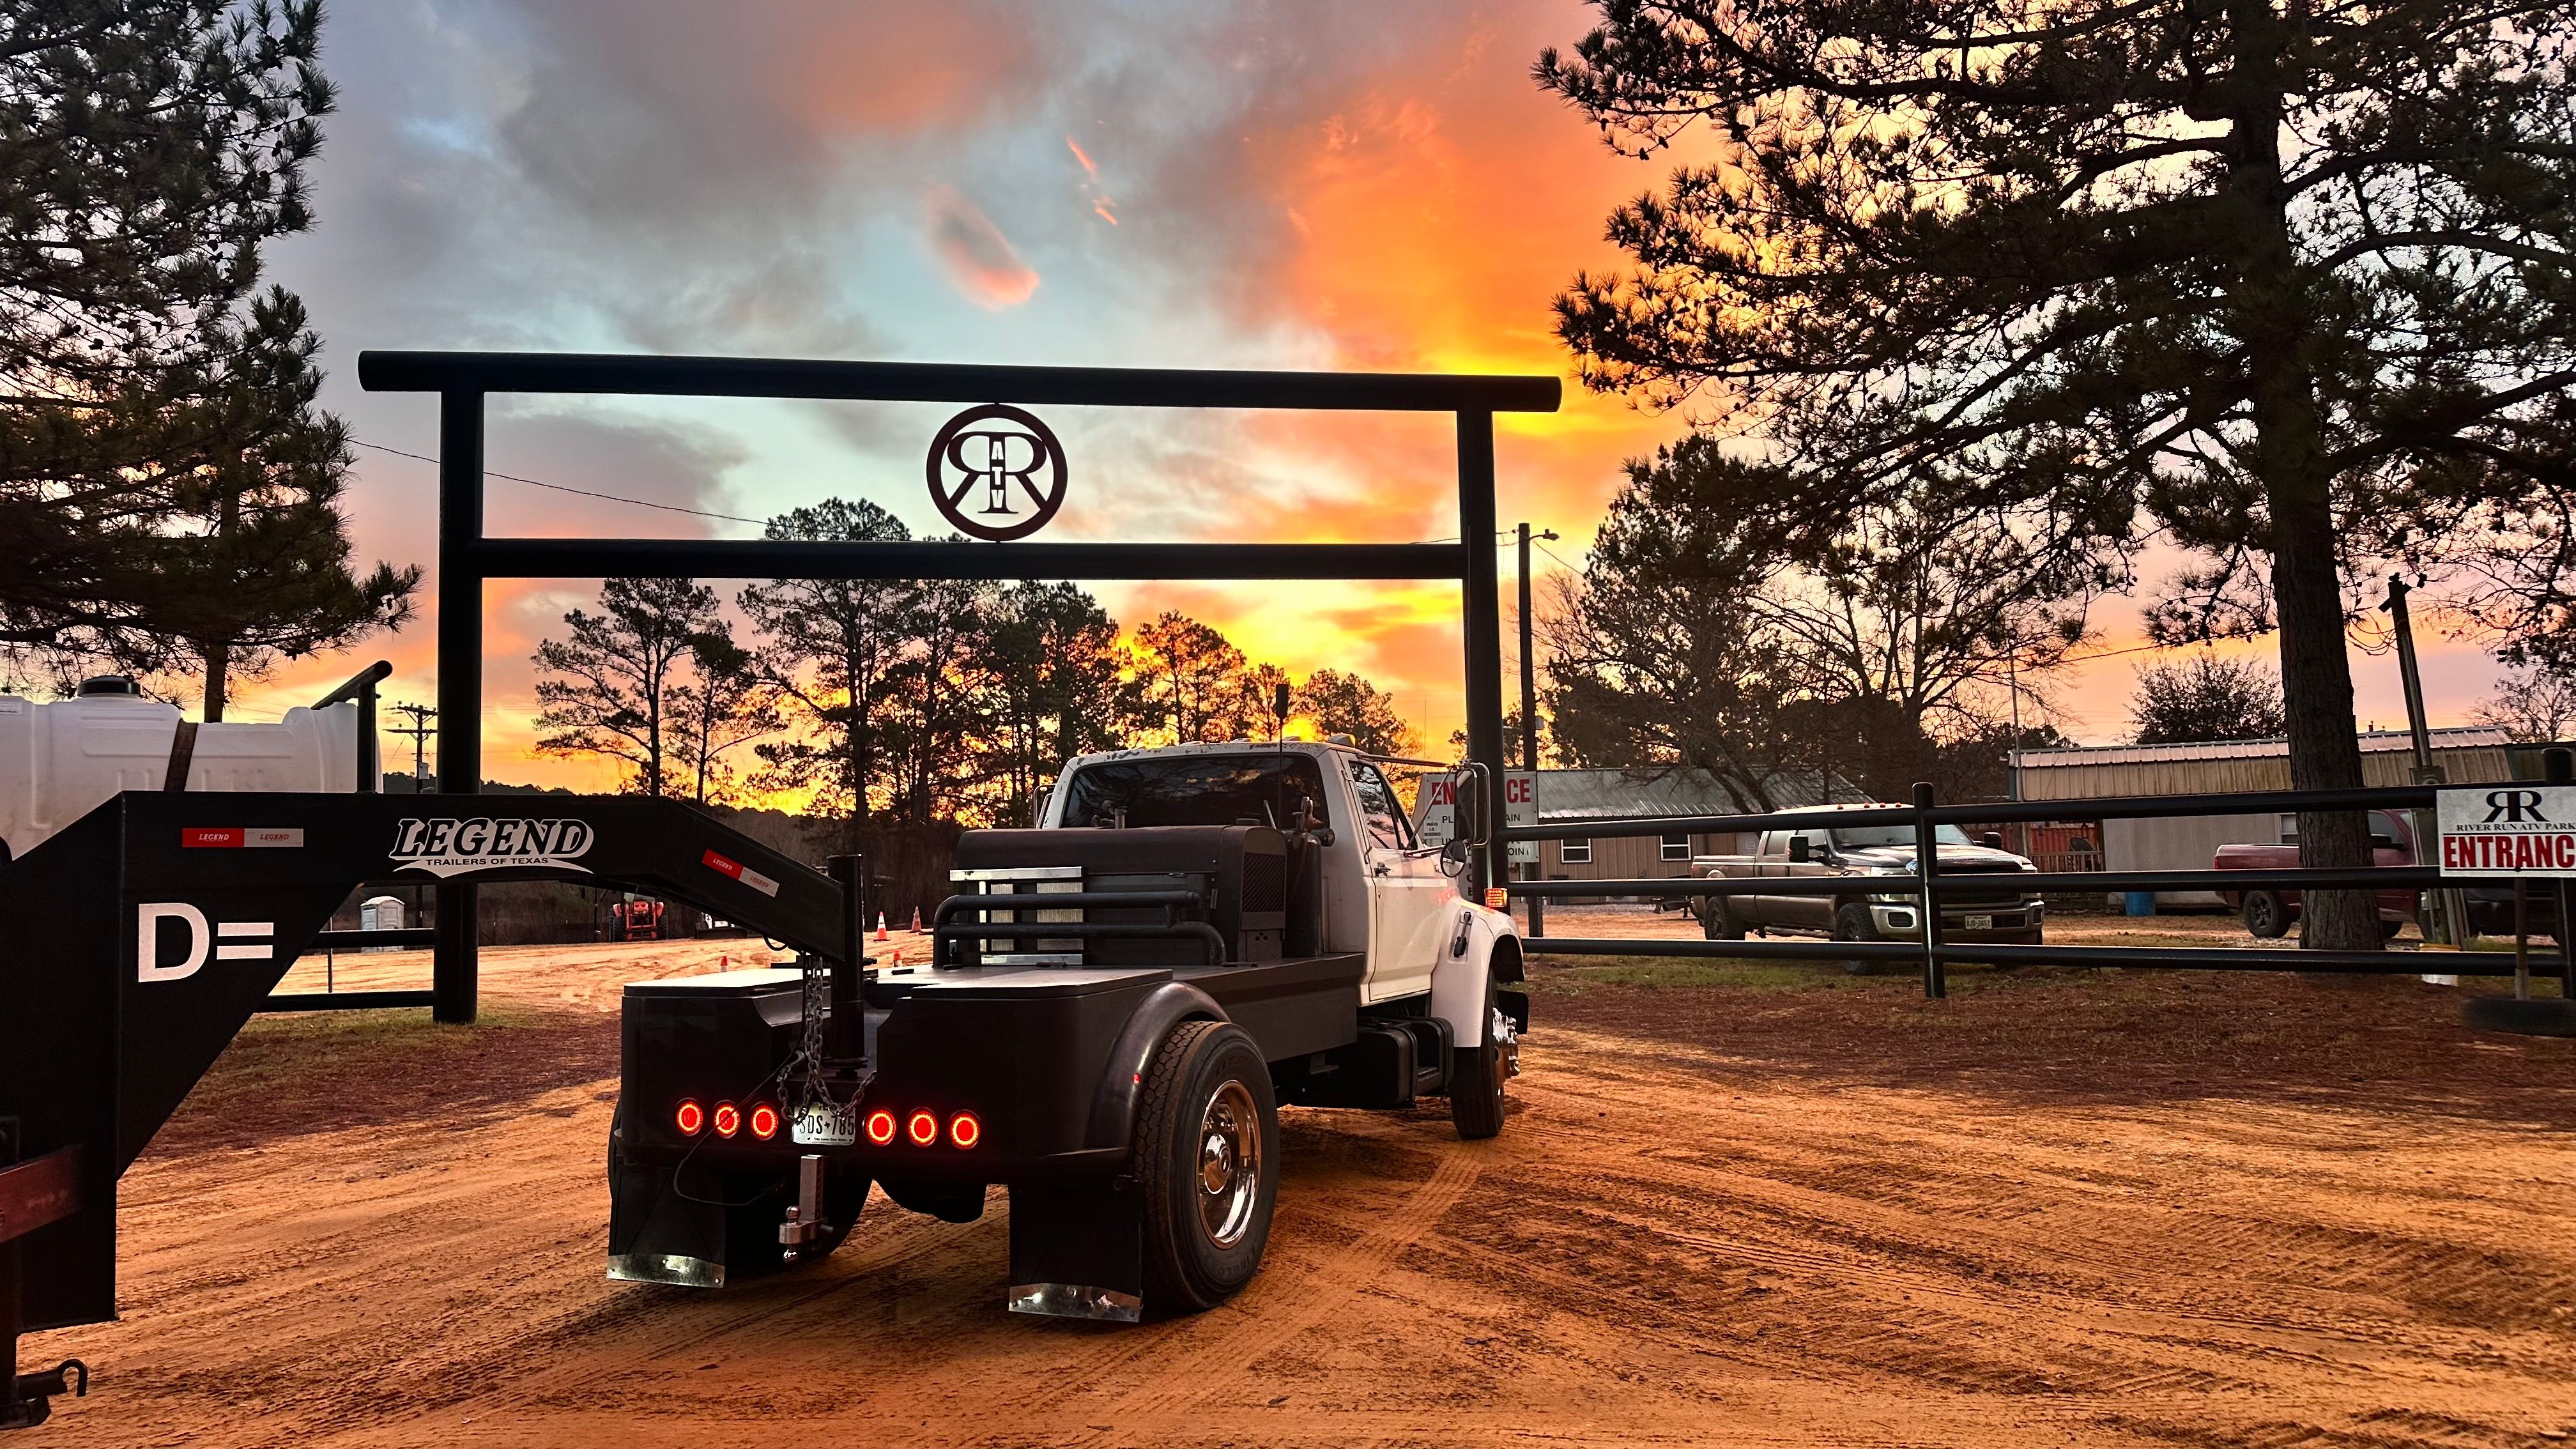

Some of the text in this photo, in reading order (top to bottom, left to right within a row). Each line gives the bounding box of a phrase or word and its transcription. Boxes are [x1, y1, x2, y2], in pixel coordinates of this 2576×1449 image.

[388, 818, 594, 860] LEGEND
[2443, 834, 2576, 868] ENTRANC
[425, 858, 487, 866] TRAILERS
[712, 857, 733, 871] LEGEND
[749, 875, 769, 888] LEGEND
